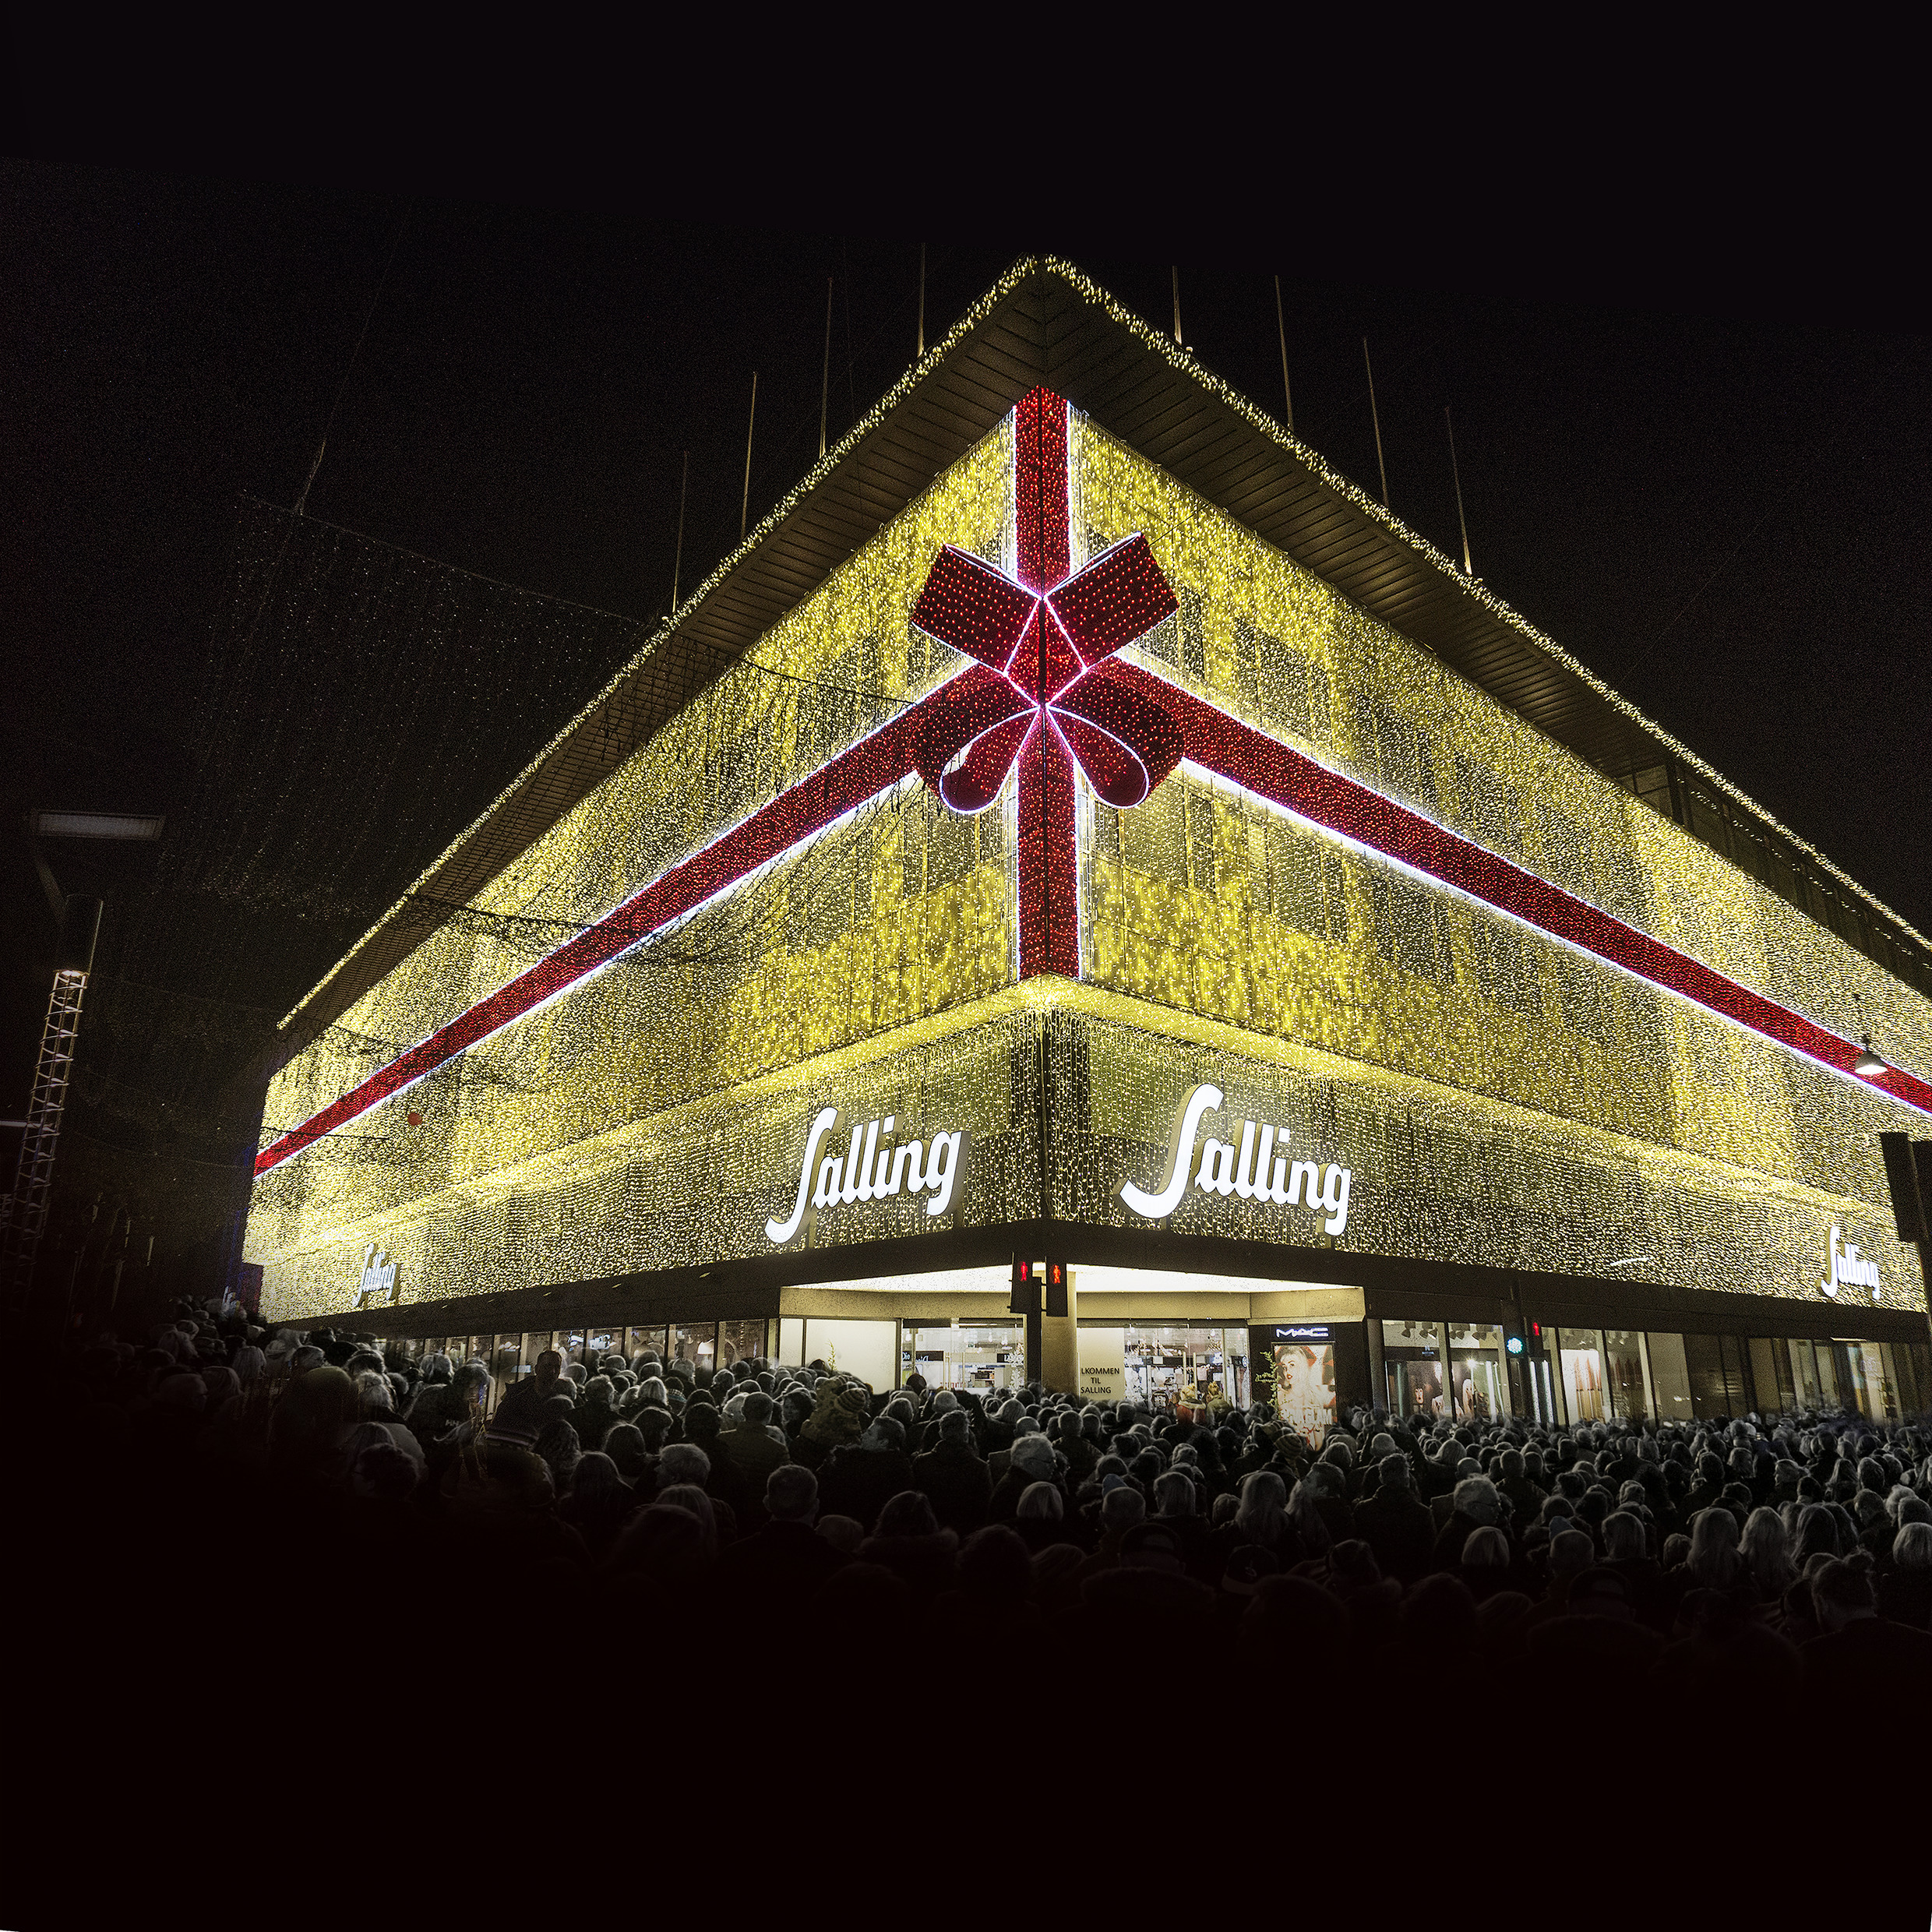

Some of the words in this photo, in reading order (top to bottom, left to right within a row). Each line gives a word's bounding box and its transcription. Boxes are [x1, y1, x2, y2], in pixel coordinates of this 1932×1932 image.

[764, 1106, 962, 1244] Salling
[1119, 1083, 1352, 1236] Salling
[351, 1243, 397, 1307] Salling
[1821, 1225, 1880, 1300] Salling
